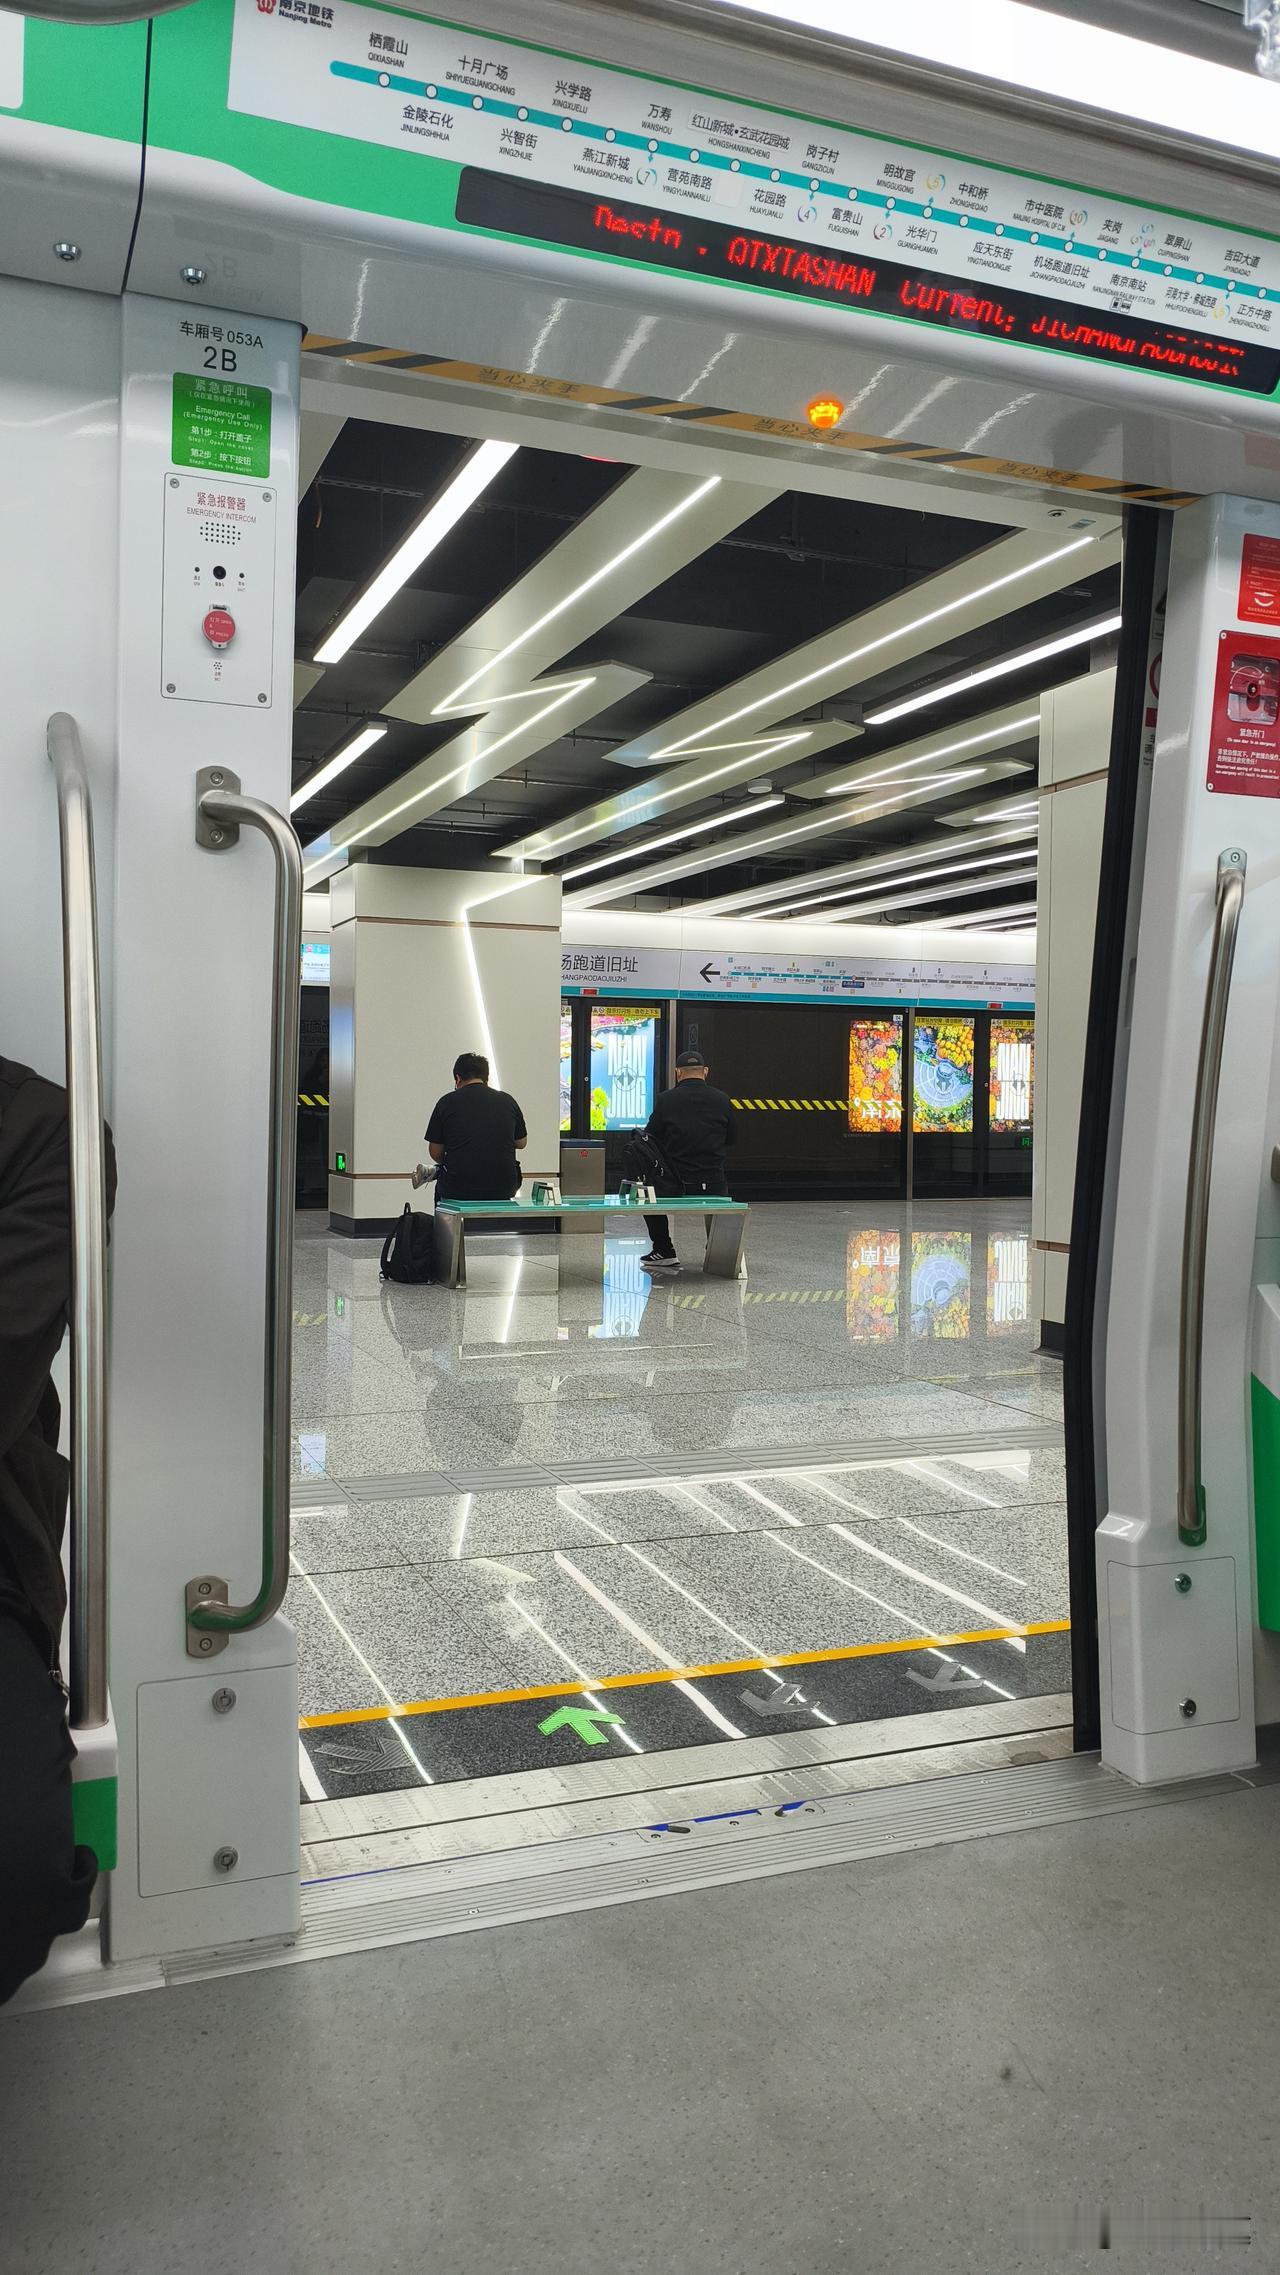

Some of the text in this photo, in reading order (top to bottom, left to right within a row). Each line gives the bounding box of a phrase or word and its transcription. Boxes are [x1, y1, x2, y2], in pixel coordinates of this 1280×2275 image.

[279, 9, 332, 28] Nanjing Metro
[368, 31, 408, 55] 栖霞山
[368, 52, 405, 68] QIXIASHAN
[457, 55, 509, 80] 十月广场
[445, 71, 516, 96] SHIYUEGUANGCHANG
[554, 79, 592, 102] 兴学路
[552, 98, 588, 114] XINGXUELU
[647, 103, 673, 122] 万寿
[402, 104, 454, 129] 金陵石化
[400, 123, 450, 141] JINLINGSHIHUA
[641, 120, 673, 135] WANSHOU
[501, 128, 538, 149] 兴智街
[708, 137, 771, 160] HONGSHANXINCHENG
[498, 146, 533, 161] XINGZHIJIE
[582, 147, 631, 171] 燕江新城
[806, 143, 840, 163] 岗子村
[573, 163, 634, 185] YANJIANGXINCHENG
[801, 160, 835, 175] GANGZICUN
[883, 163, 917, 186] 明故宫
[667, 167, 713, 190] 营苑南路
[876, 178, 915, 195] MINGGUGONG
[662, 184, 712, 203] YINGYUANNANLU
[753, 188, 787, 208] 花园路
[958, 182, 989, 200] 中和桥
[749, 205, 784, 219] HUAYUANLU
[832, 206, 864, 226] 富贵山
[1025, 198, 1065, 220] 市中医院
[828, 222, 860, 238] FUGUISHAN
[906, 224, 938, 244] 光华门
[1102, 219, 1123, 234] 夹岗
[897, 239, 939, 256] GUANGHUAMEN
[973, 241, 1014, 261] 应天东街
[1163, 233, 1193, 251] 翠屏山
[1034, 255, 1090, 279] 机场跑道旧址
[1223, 249, 1262, 268] 吉印大道
[1109, 273, 1148, 292] 南京南站
[1237, 303, 1273, 322] 正方中路
[180, 320, 264, 349] 车厢号 053A
[203, 345, 237, 372] 2B
[194, 378, 248, 399] 紧急呼叫
[195, 405, 251, 421] Emergency Call
[197, 491, 246, 512] 紧急报警器
[186, 506, 257, 524] EMERGENCY INTERCOM
